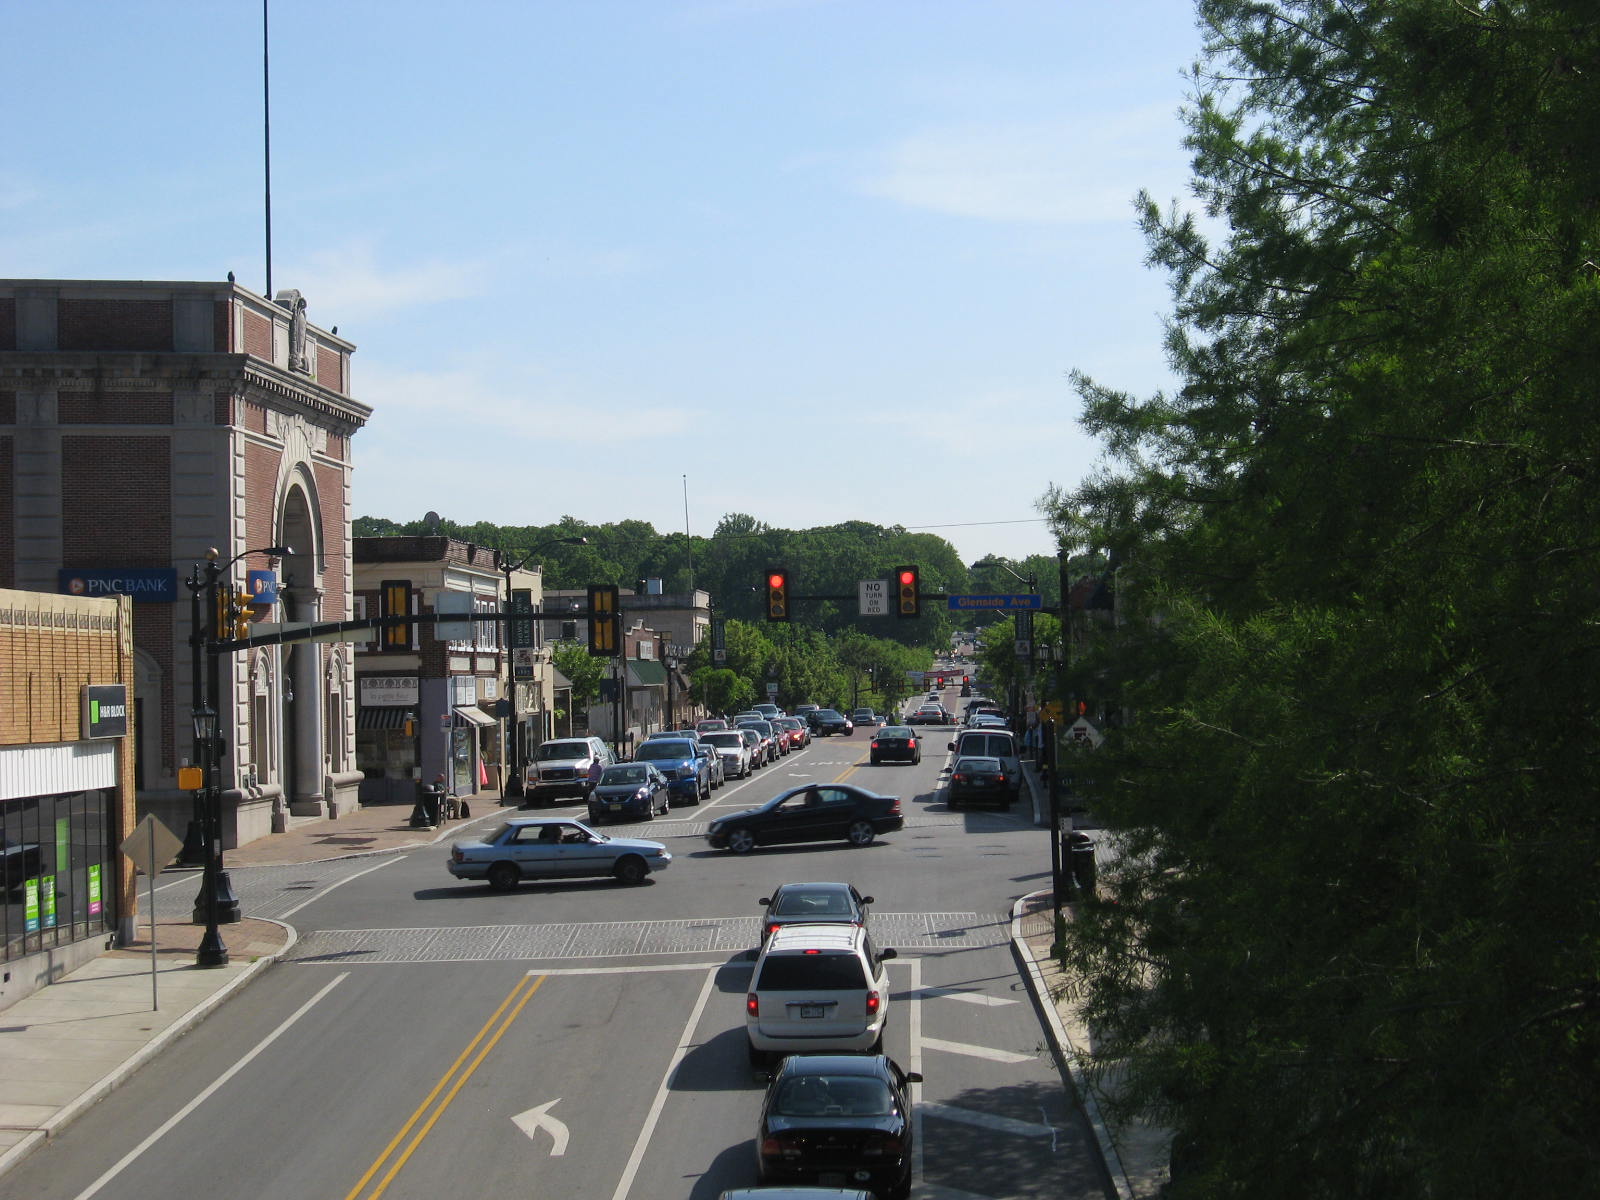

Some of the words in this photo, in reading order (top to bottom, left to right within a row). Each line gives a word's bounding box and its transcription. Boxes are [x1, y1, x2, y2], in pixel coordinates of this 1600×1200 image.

[88, 579, 122, 592] PNC
[125, 579, 167, 592] BANK
[866, 583, 880, 591] NO
[958, 597, 1005, 607] Glenside
[1011, 596, 1031, 606] Ave
[100, 705, 111, 718] H&R
[110, 705, 126, 718] BLOCK
